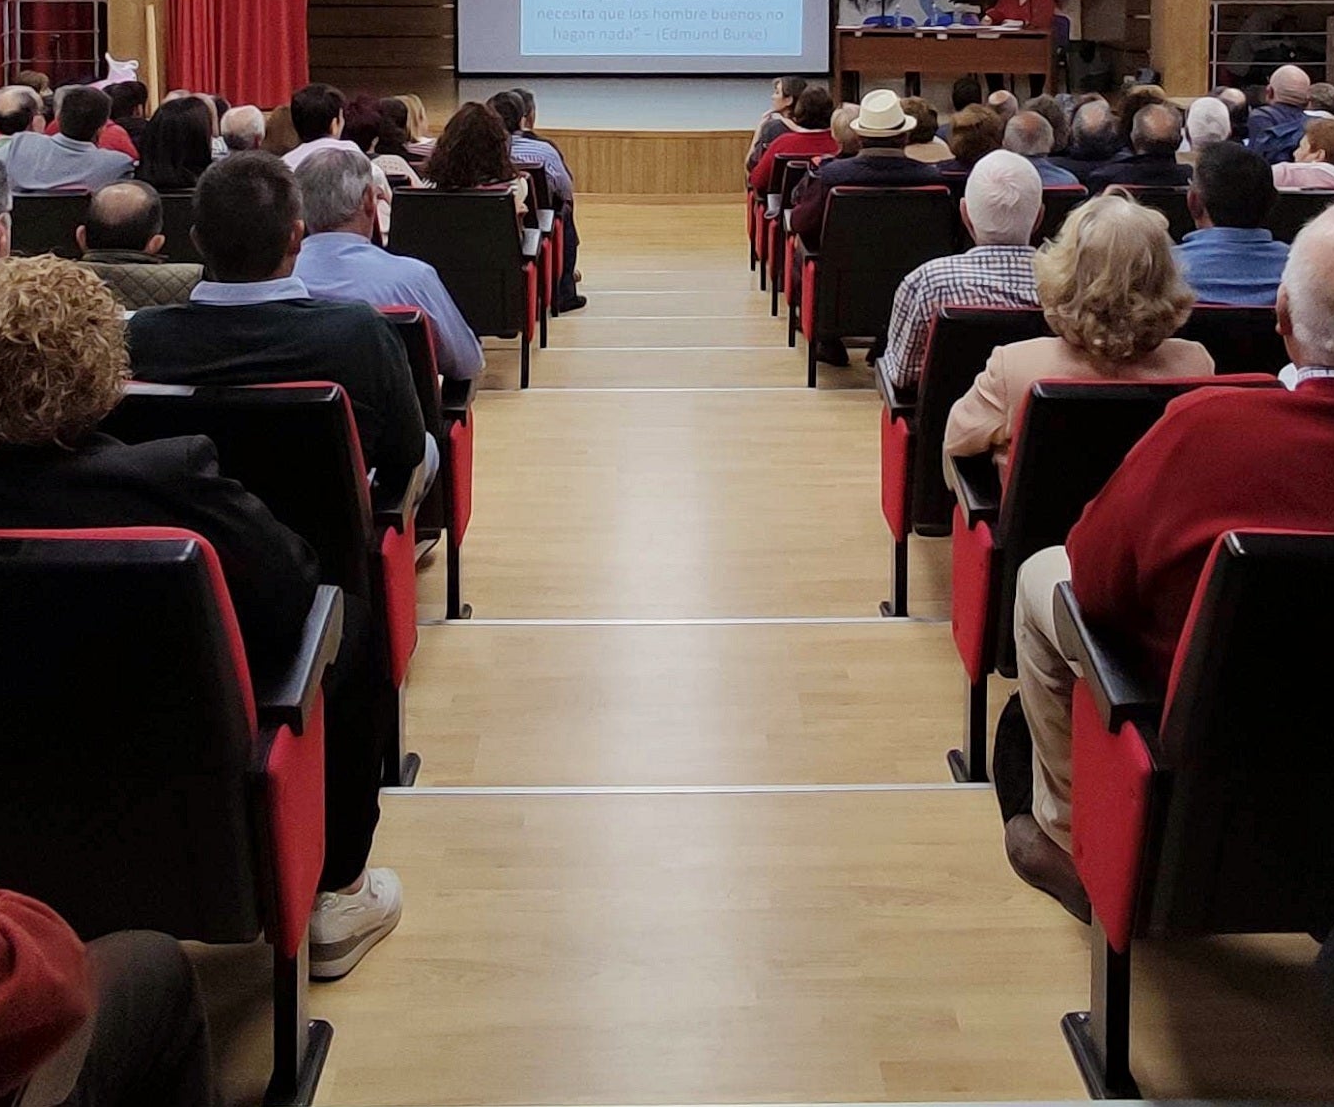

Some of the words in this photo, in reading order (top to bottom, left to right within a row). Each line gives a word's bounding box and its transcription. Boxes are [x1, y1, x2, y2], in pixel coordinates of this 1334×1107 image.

[537, 8, 595, 20] necesita
[598, 10, 625, 22] que
[629, 8, 649, 20] los
[653, 8, 707, 21] hombre
[711, 8, 763, 21] buenos
[766, 10, 784, 21] no
[553, 26, 595, 44] hagan
[657, 27, 719, 43] (Edmund
